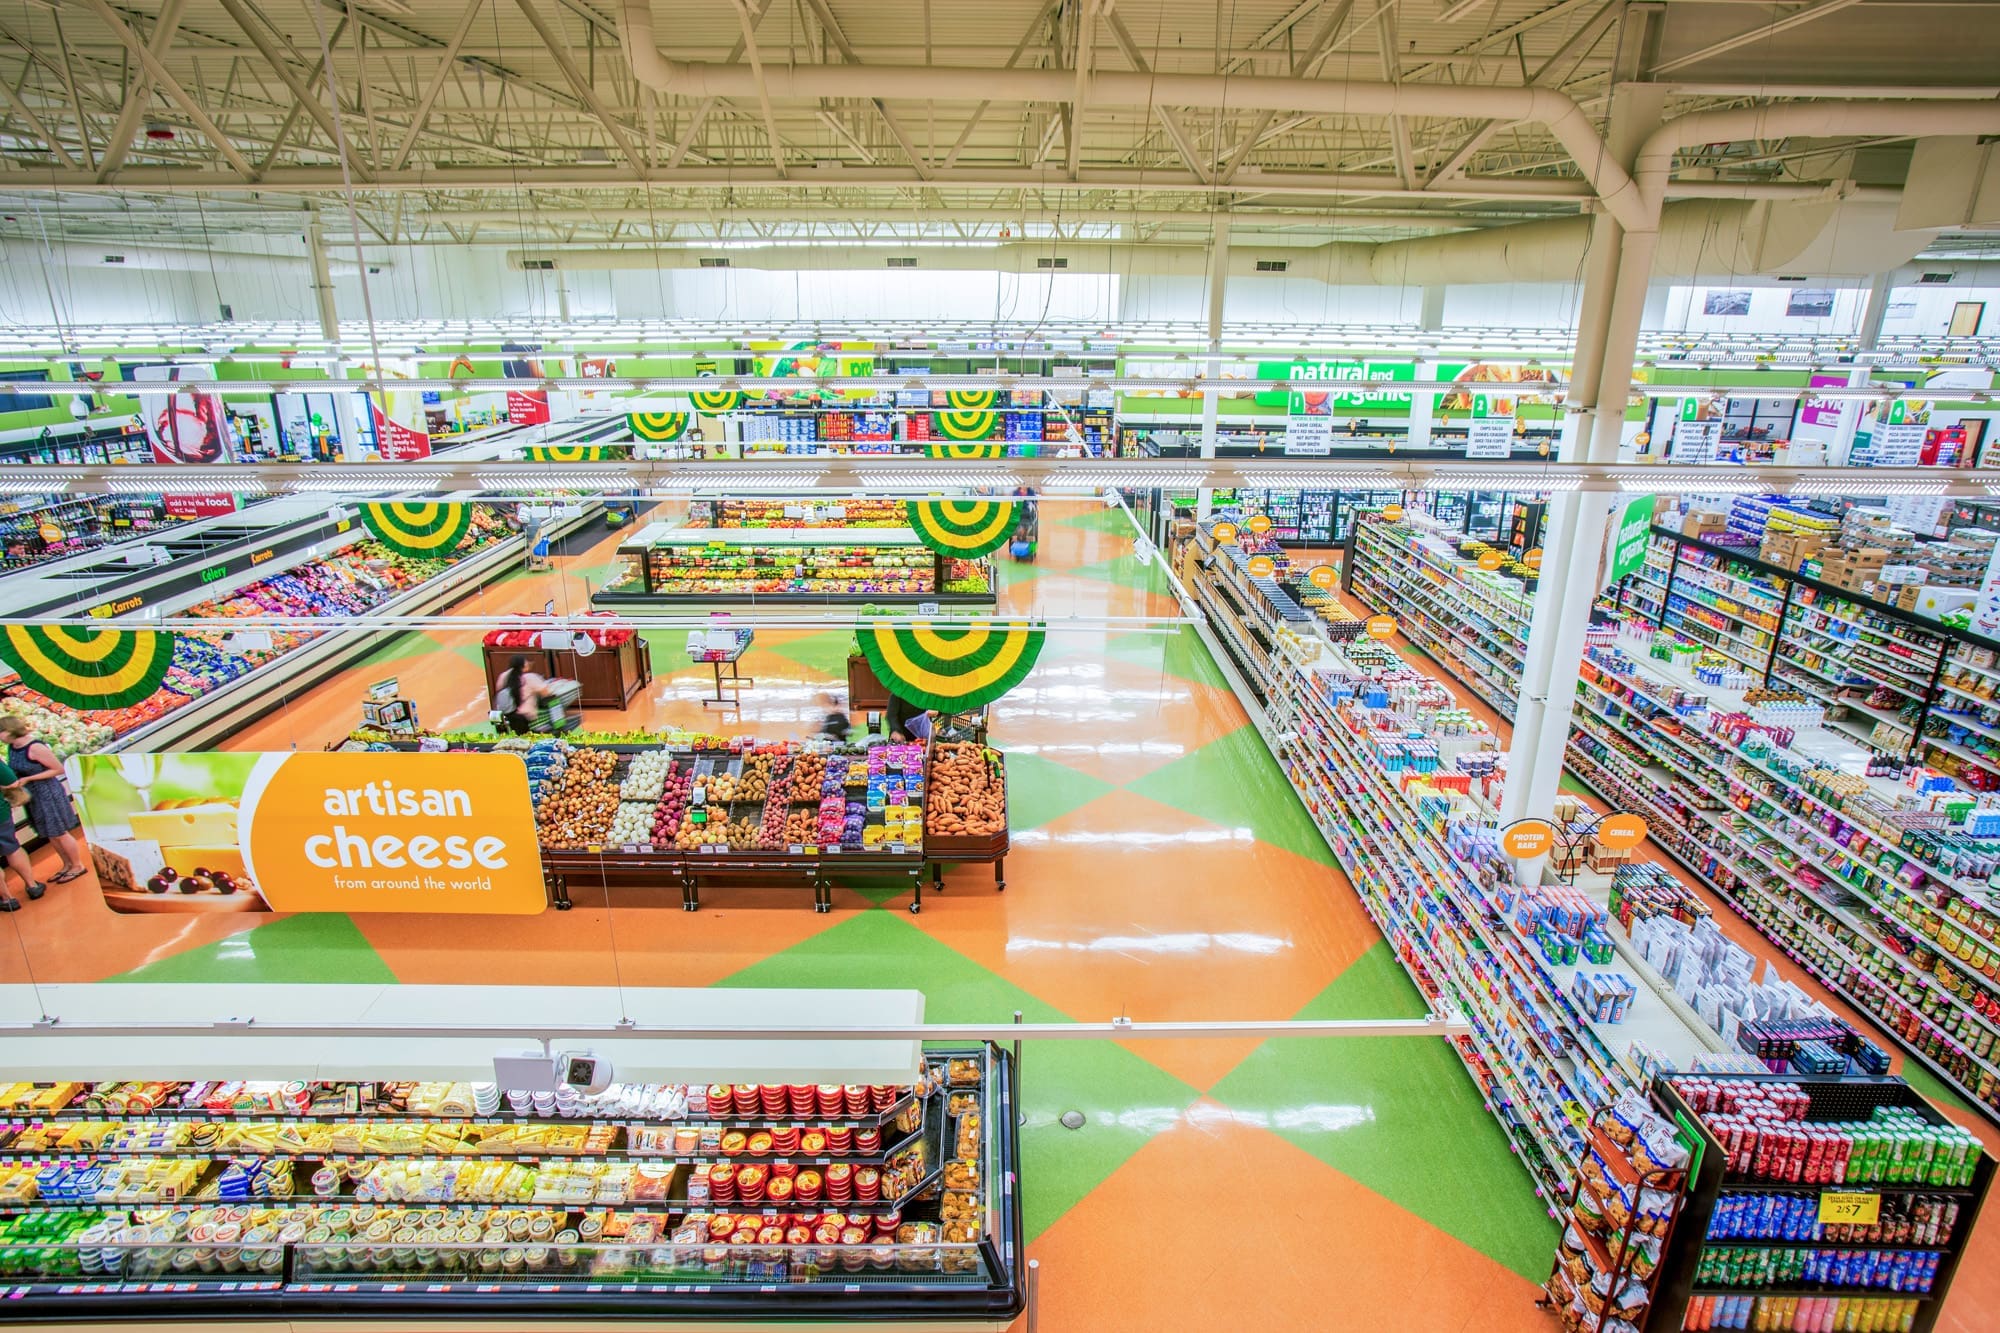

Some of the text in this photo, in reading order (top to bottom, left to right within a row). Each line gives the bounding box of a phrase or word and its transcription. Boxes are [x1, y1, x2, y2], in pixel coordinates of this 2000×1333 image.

[1289, 361, 1394, 381] natural and
[1294, 396, 1300, 408] 1
[1477, 400, 1484, 411] 2
[1686, 404, 1694, 414] 3
[1894, 406, 1902, 418] 4
[205, 498, 231, 506] food.
[252, 550, 274, 564] Carrots
[202, 566, 226, 582] Celery
[112, 596, 142, 614] Carrots
[323, 780, 472, 816] artisan
[304, 825, 508, 870] cheese
[334, 874, 492, 890] from around the world
[1836, 1204, 1861, 1216] 2/$7
